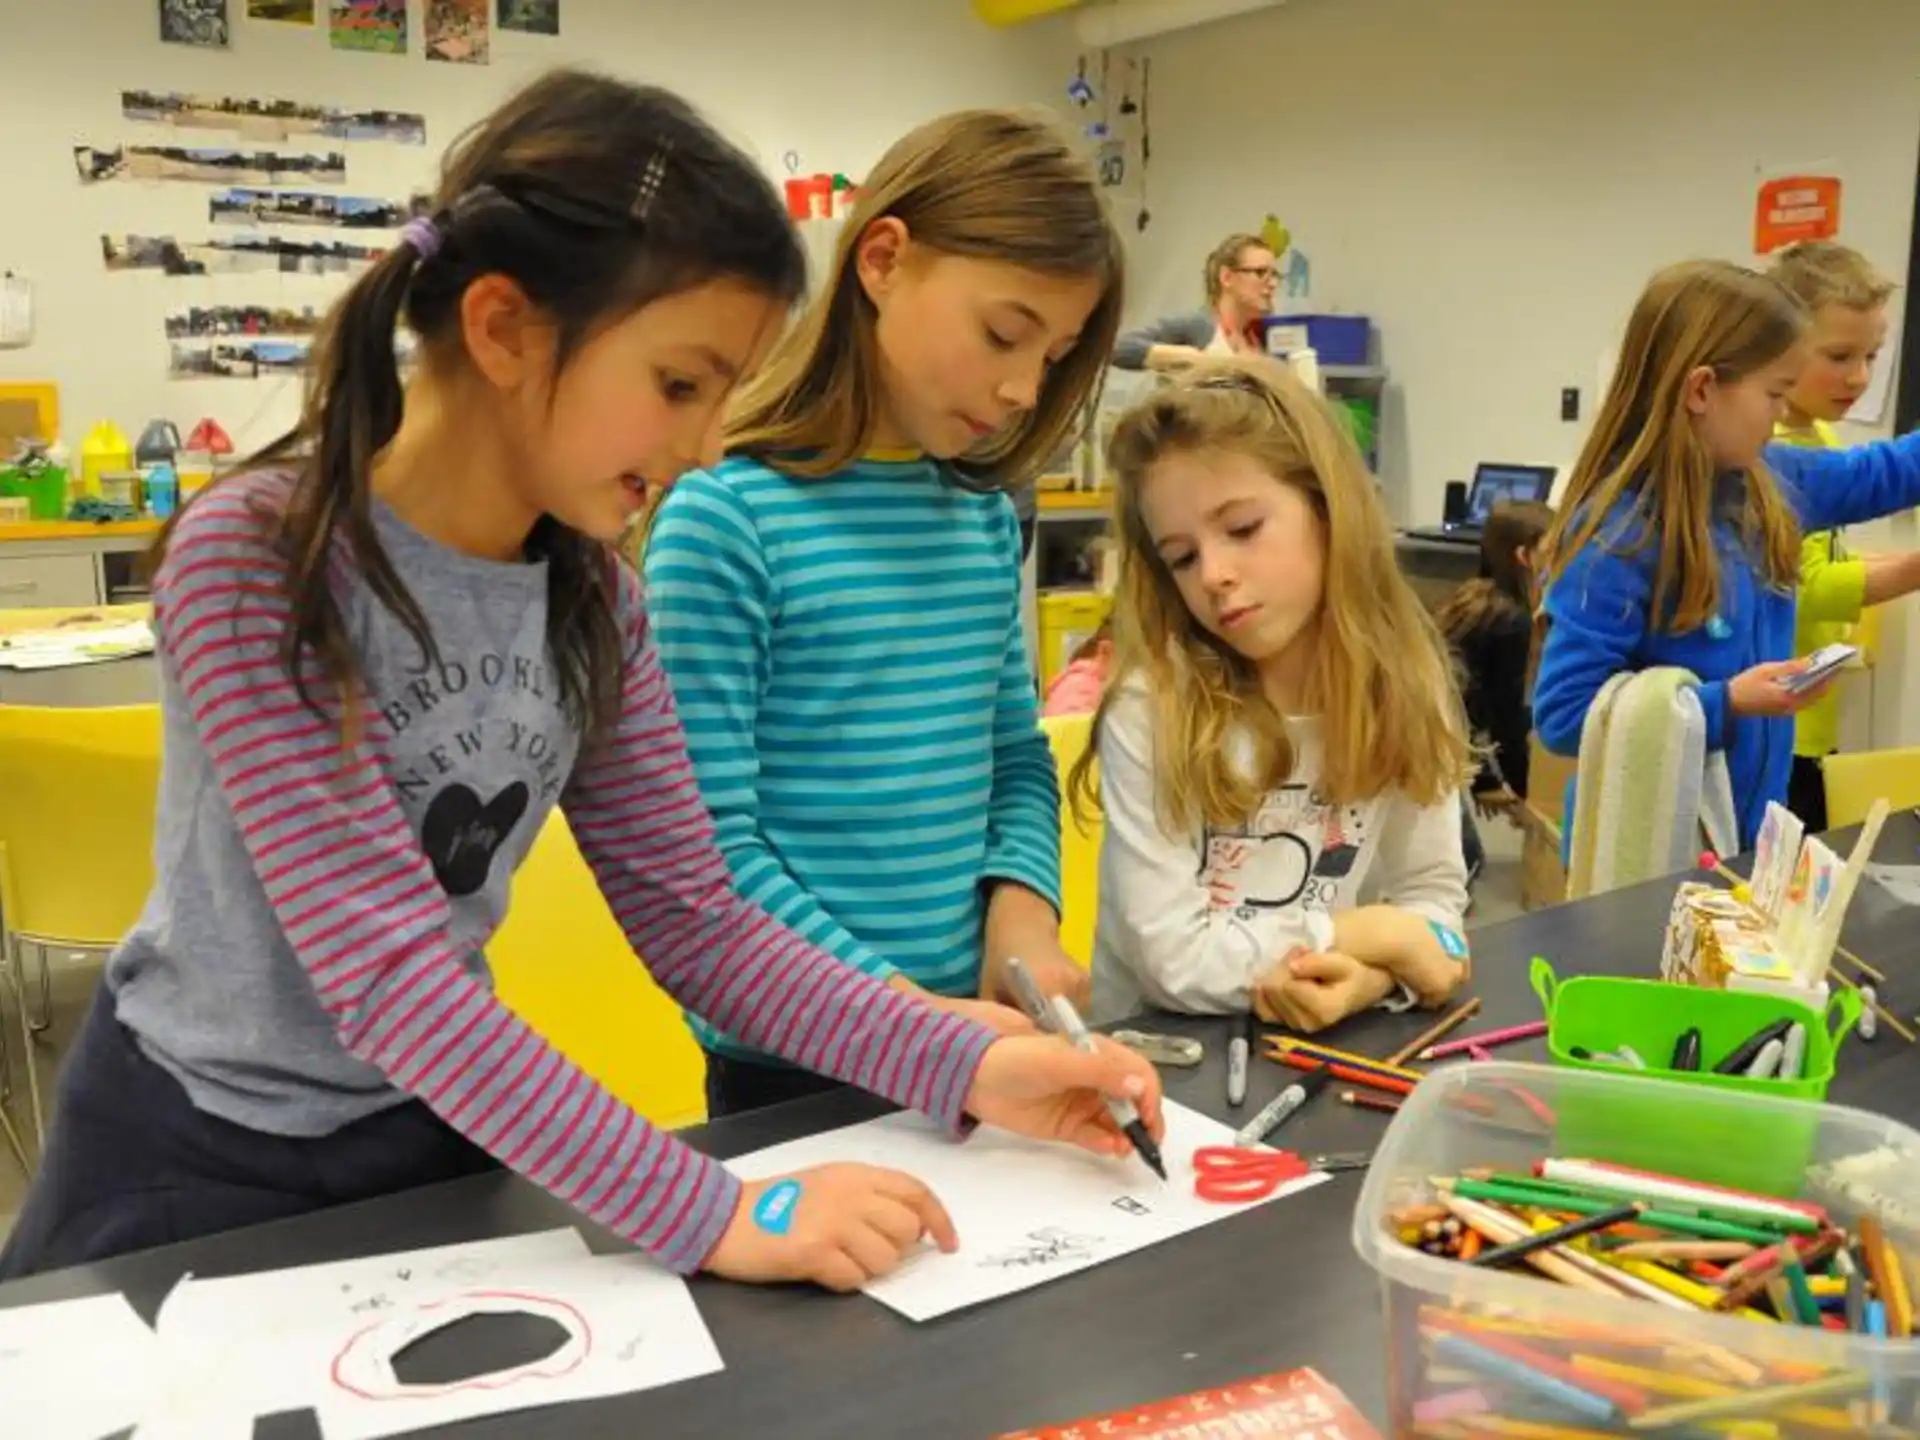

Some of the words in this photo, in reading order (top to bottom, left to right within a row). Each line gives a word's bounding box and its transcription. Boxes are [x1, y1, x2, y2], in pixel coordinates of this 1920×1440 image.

[384, 654, 564, 732] BROOKL
[397, 726, 484, 801] NEW
[504, 722, 560, 799] YORK
